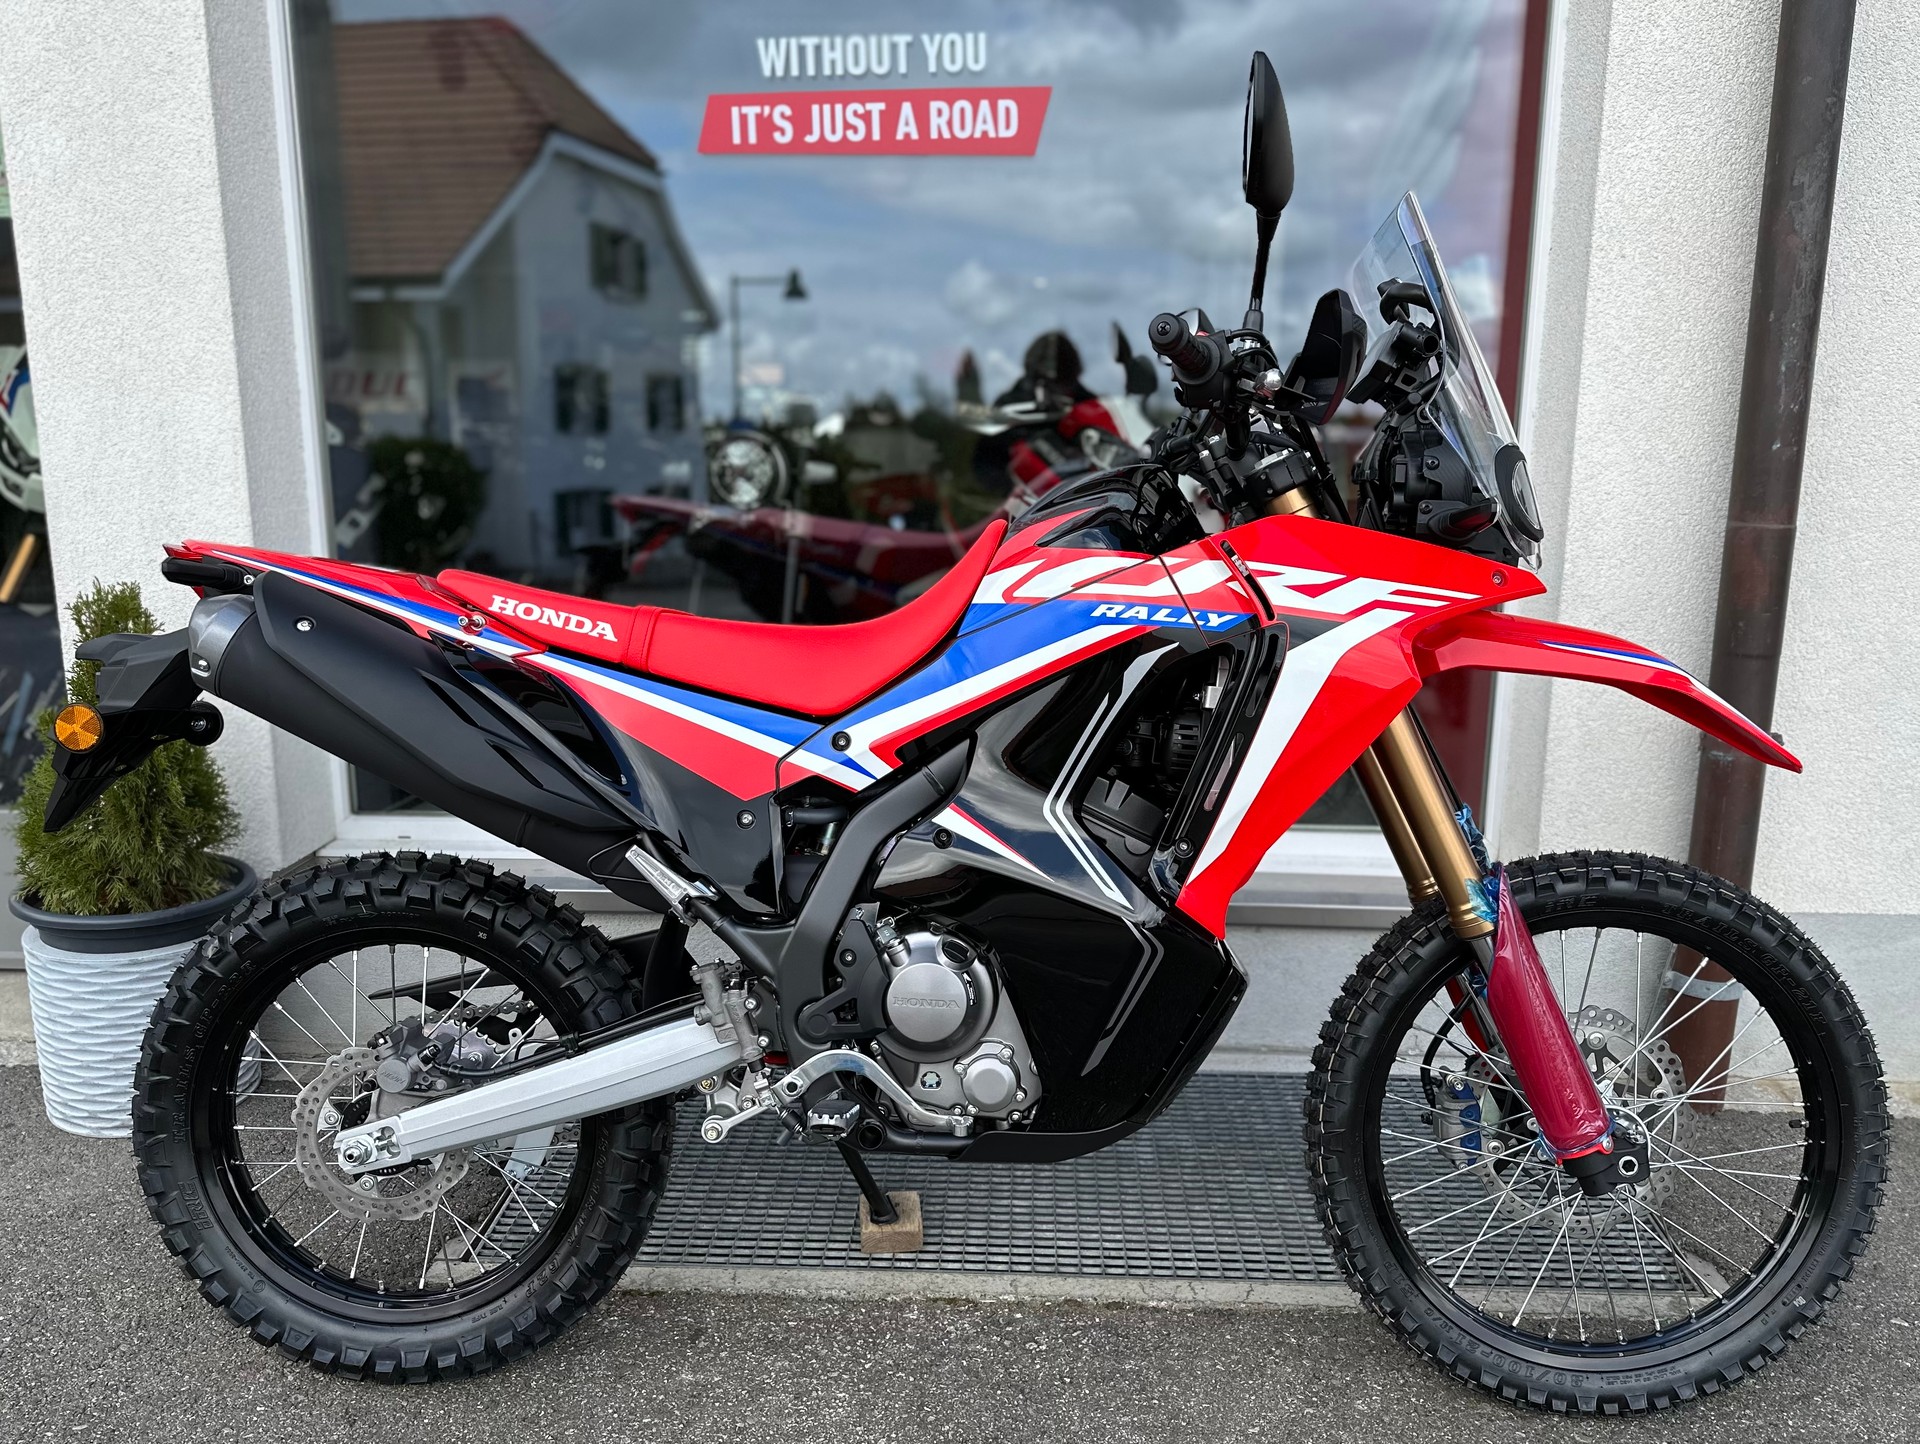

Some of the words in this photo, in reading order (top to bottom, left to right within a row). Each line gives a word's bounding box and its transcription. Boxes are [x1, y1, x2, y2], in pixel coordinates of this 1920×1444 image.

[757, 36, 912, 77] WITHOUT
[921, 32, 986, 73] YOU
[731, 105, 793, 145] IT'S
[804, 102, 885, 144] JUST
[896, 101, 919, 140] A
[929, 99, 1018, 139] ROAD
[488, 595, 618, 642] HONDA
[1090, 603, 1238, 627] RALLY
[892, 996, 961, 1009] HONDA
